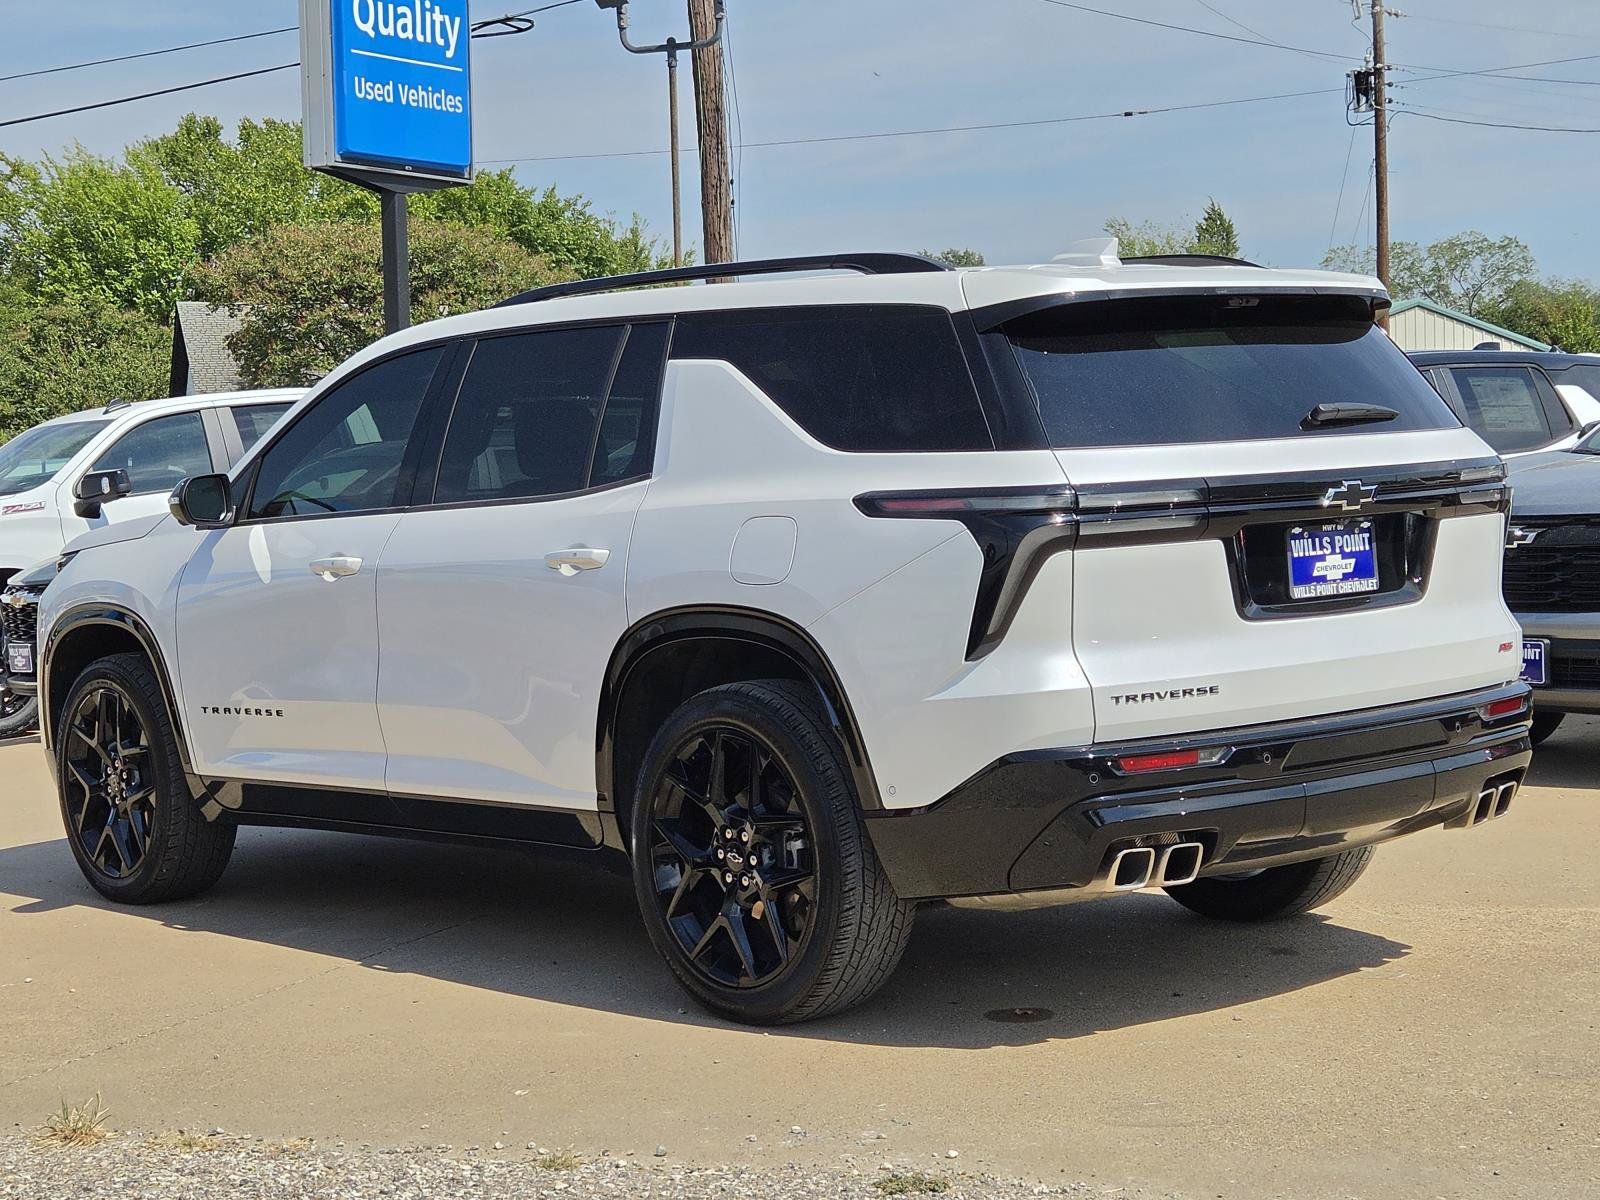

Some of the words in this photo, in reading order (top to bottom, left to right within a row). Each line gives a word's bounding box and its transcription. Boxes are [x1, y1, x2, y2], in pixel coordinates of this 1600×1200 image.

[352, 0, 461, 58] Quality
[354, 76, 394, 103] Used
[398, 83, 463, 113] Vehicles
[1322, 524, 1336, 532] HWY
[1291, 537, 1332, 558] WILLS
[1334, 533, 1370, 554] POINT
[1316, 562, 1353, 573] CHEVROLET
[1293, 586, 1316, 599] WILLS
[1316, 583, 1338, 595] POINT
[1338, 579, 1378, 593] CHEVROLET
[1110, 685, 1219, 705] TRAVERSE
[200, 706, 284, 717] TRAVERSE
